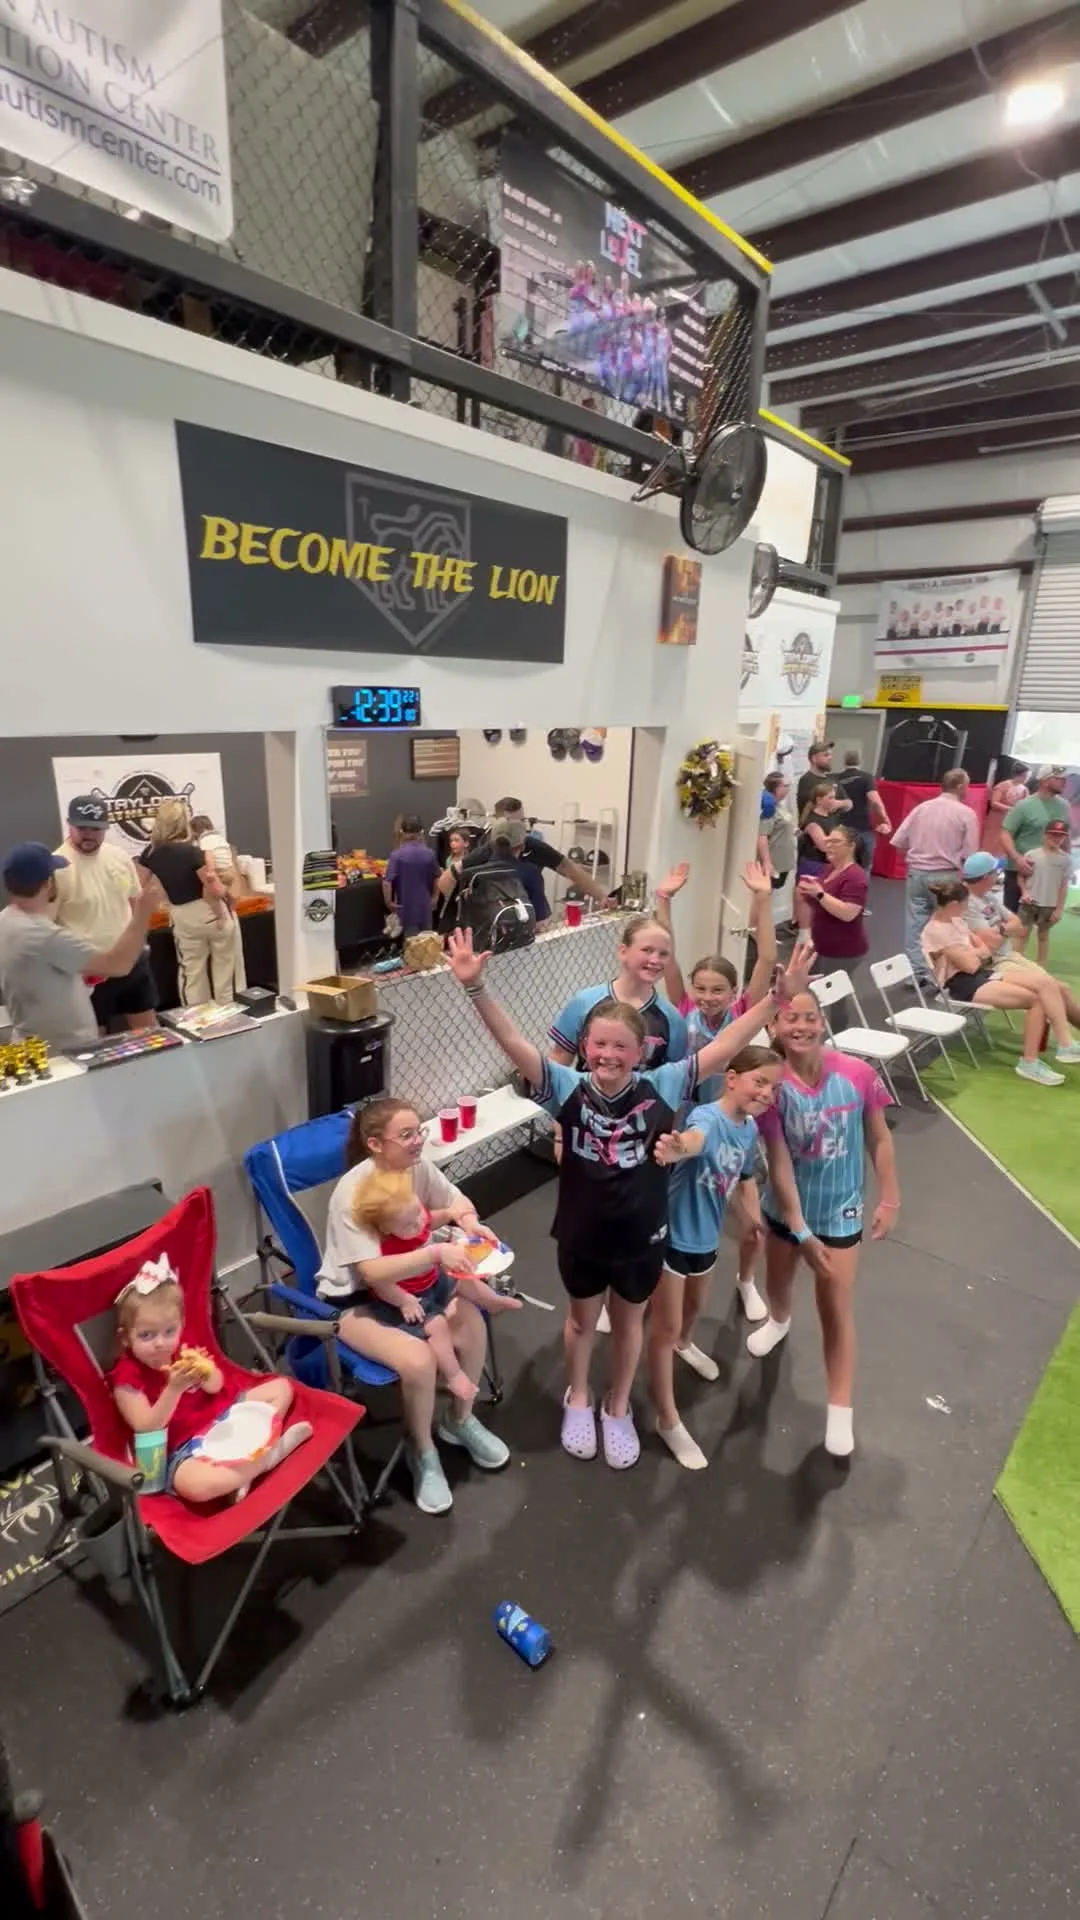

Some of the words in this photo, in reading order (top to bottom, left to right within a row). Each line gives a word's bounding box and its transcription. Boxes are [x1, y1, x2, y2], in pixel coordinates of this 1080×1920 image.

[33, 1, 156, 90] AUTISM
[104, 80, 220, 165] CENTER
[200, 514, 396, 582] BECOME
[410, 550, 478, 593] THE
[488, 564, 560, 605] LION
[571, 1126, 648, 1168] LEVEL
[580, 1099, 657, 1138] NEXT
